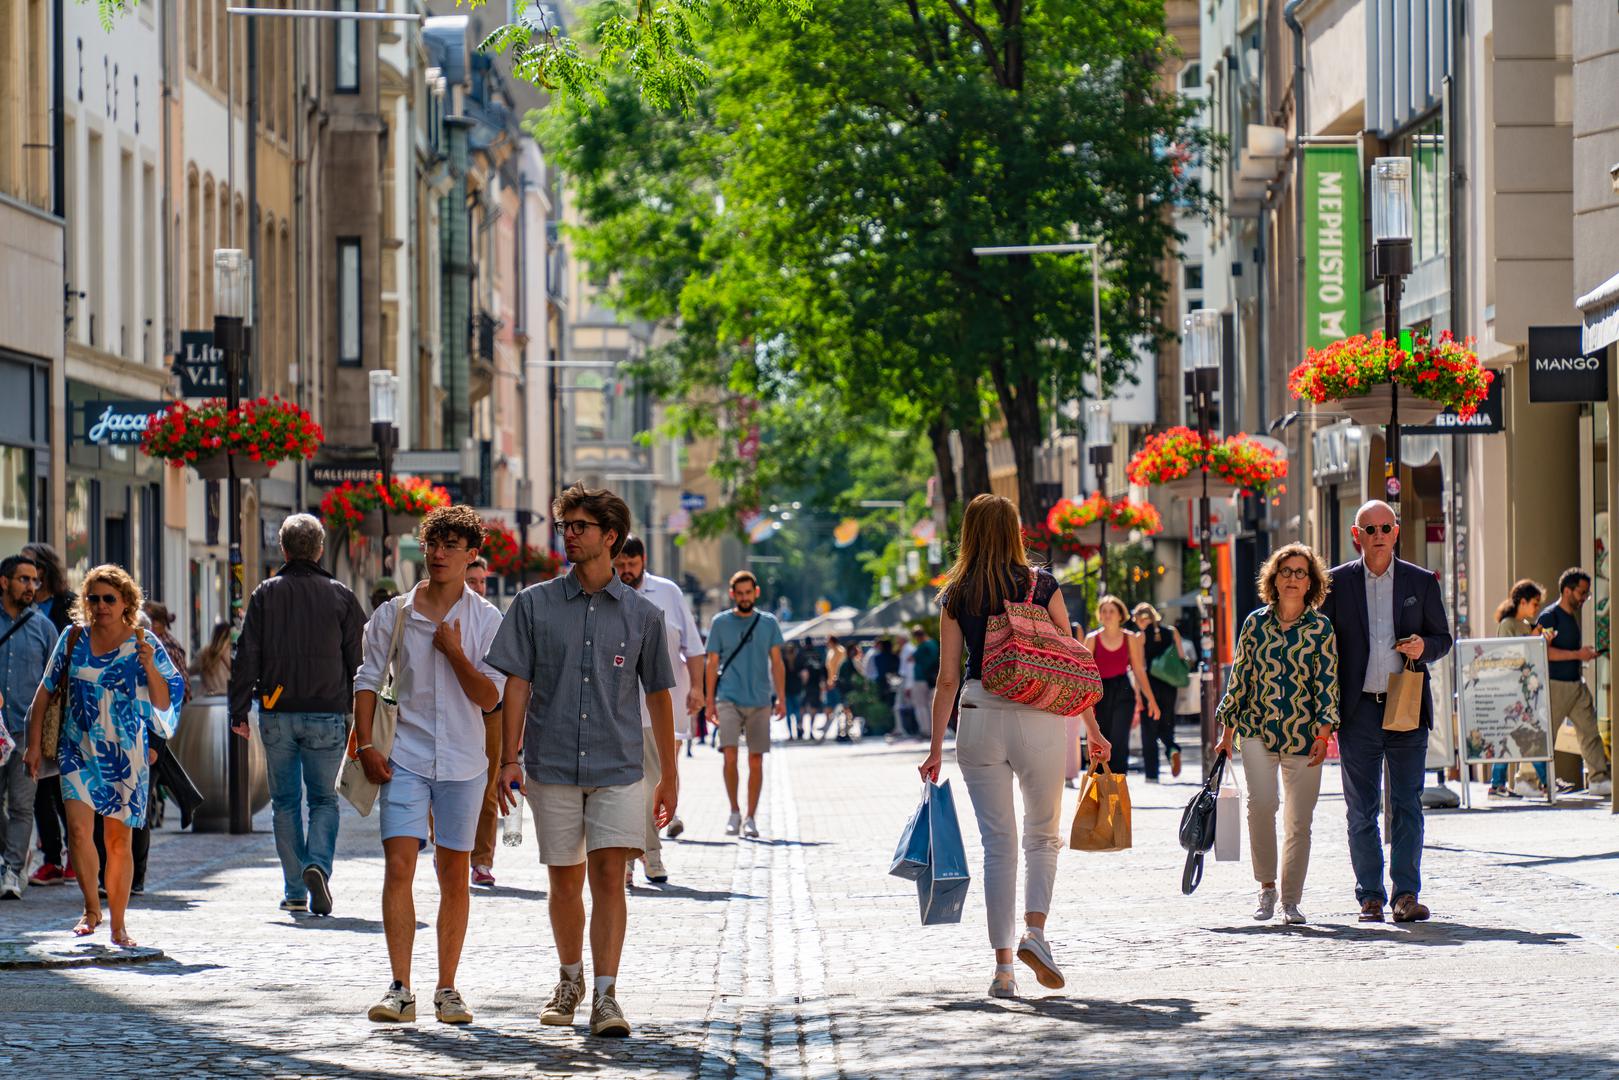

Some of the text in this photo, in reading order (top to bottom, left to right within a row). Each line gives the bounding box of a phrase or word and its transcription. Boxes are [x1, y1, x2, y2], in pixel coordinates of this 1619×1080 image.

[1318, 171, 1345, 304] MEPHISTO
[1535, 357, 1600, 371] MANGO
[88, 405, 168, 441] jaca
[1436, 413, 1493, 427] EDONIA
[314, 469, 381, 481] HALLHUBE
